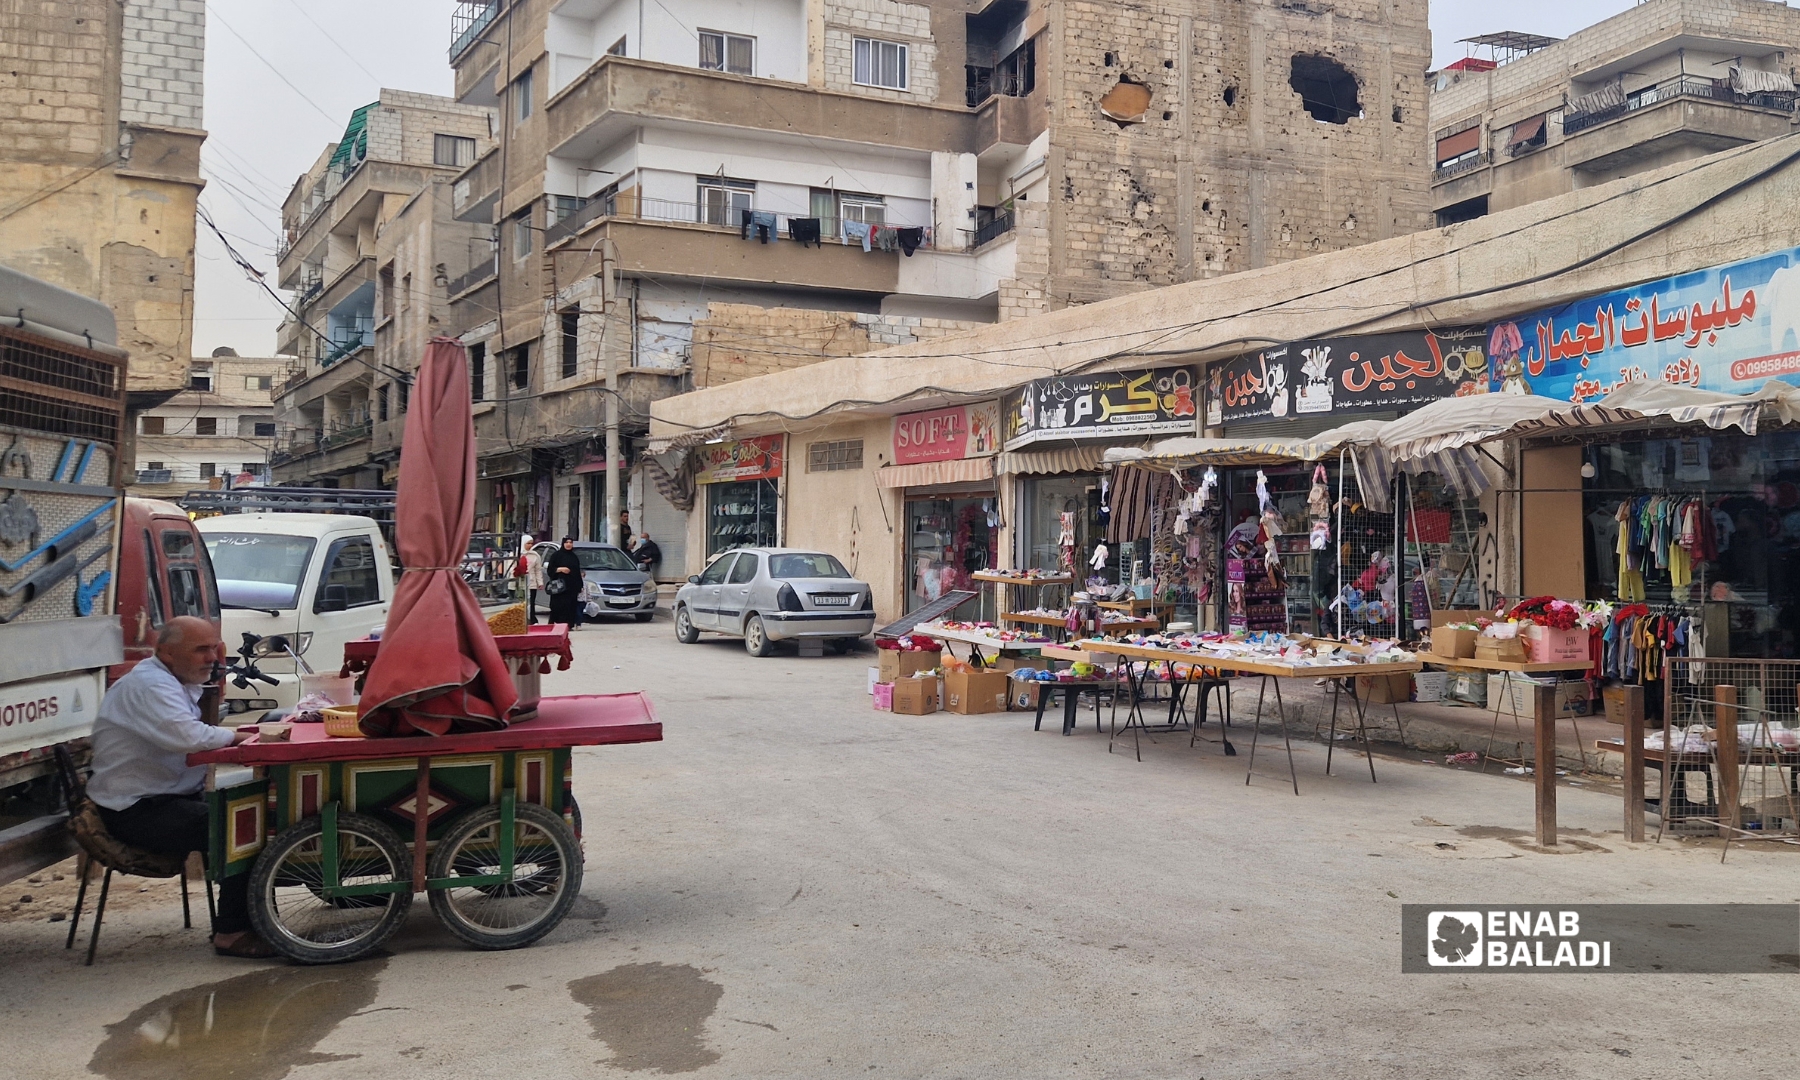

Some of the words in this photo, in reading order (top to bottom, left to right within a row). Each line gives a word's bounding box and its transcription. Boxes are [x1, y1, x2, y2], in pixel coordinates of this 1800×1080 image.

[1620, 275, 1757, 349] ملبوسات
[1342, 333, 1444, 392] لجين
[1527, 302, 1616, 377] الجمال
[1070, 372, 1158, 426] كرم
[1073, 383, 1093, 393] وهدايا
[1225, 353, 1267, 407] لجين
[898, 414, 958, 447] SOFT
[0, 696, 58, 728] OTORS
